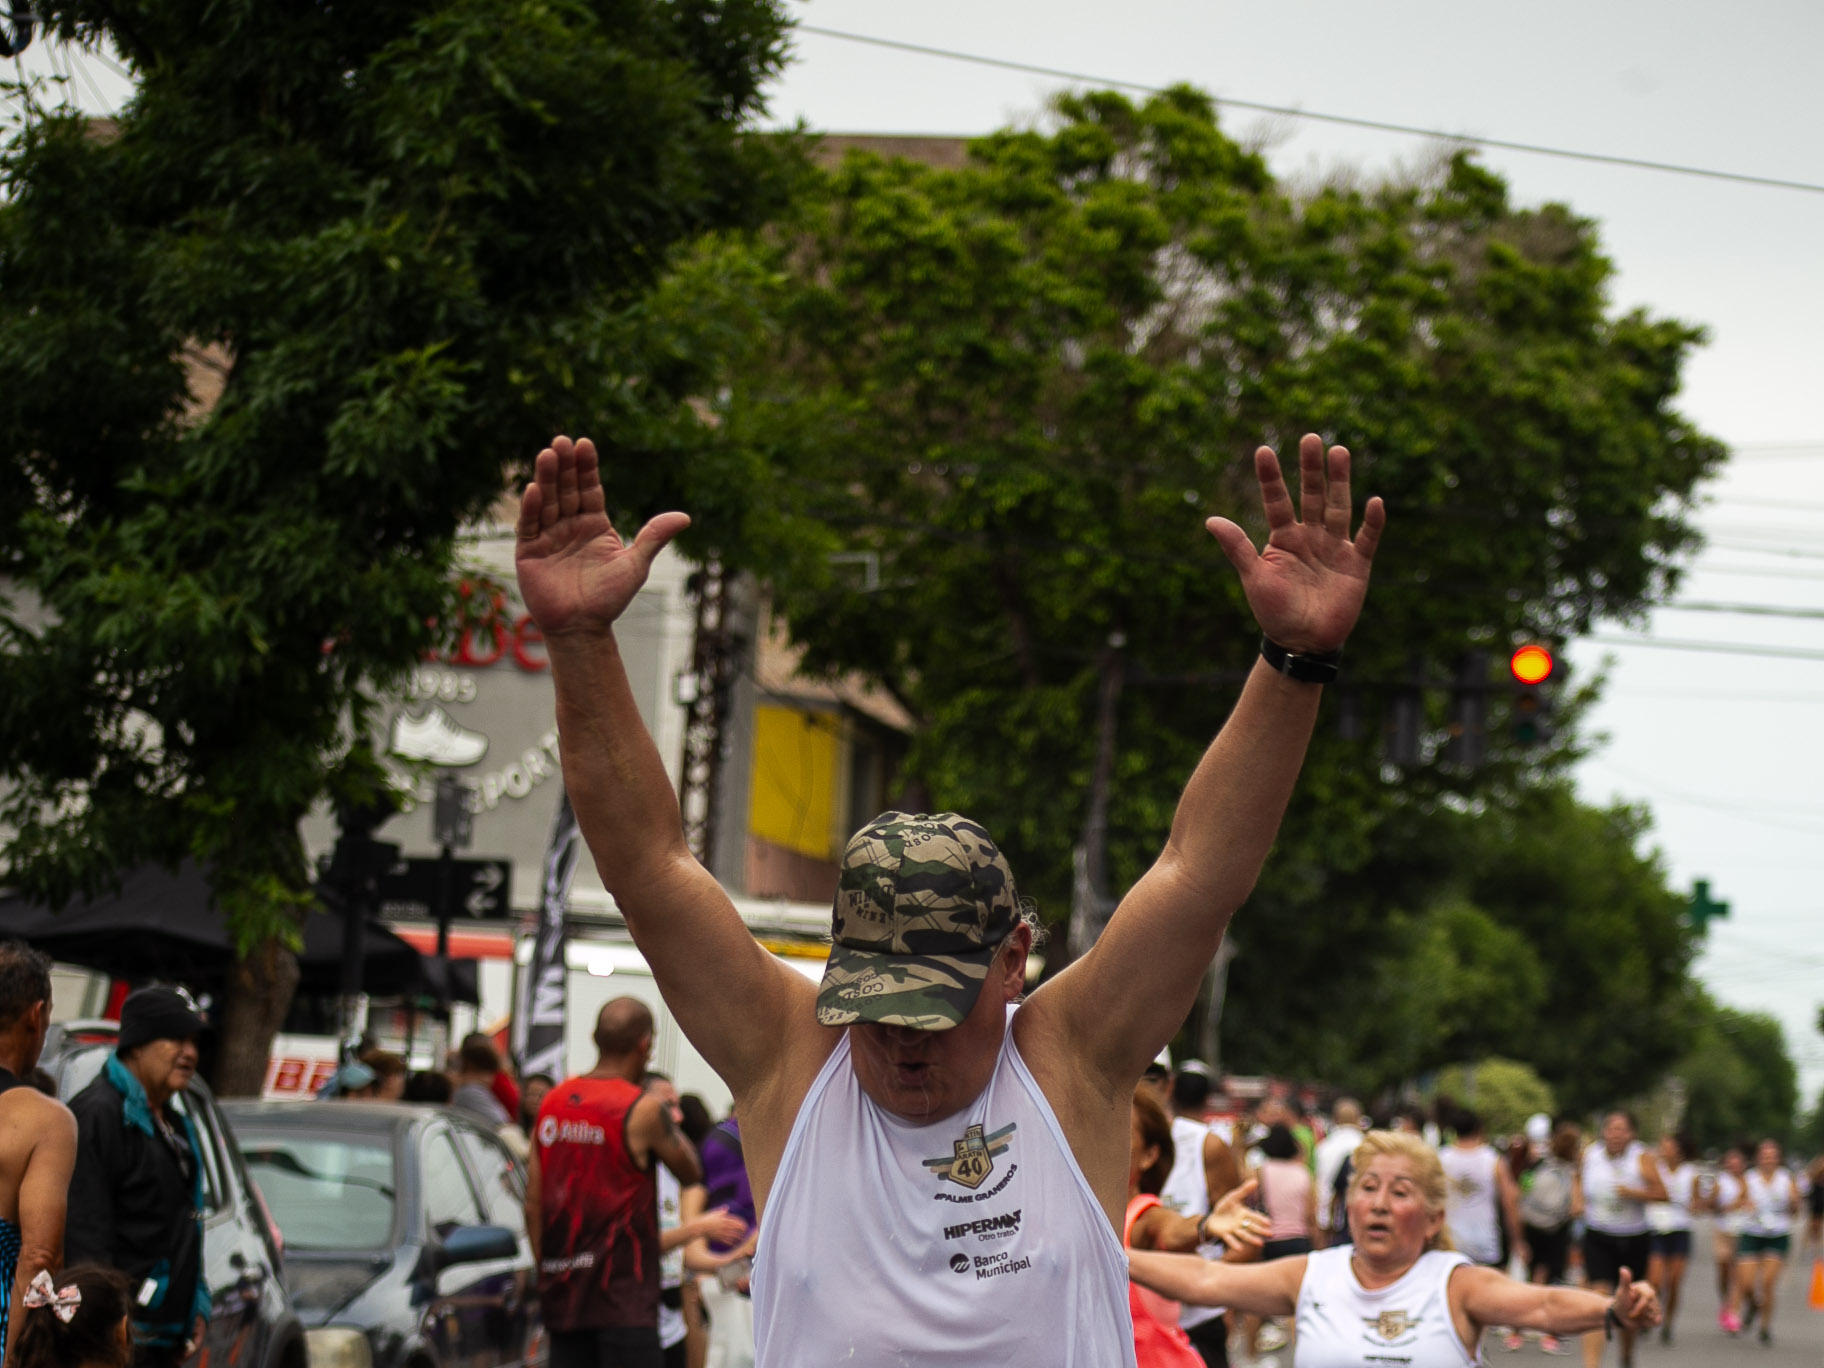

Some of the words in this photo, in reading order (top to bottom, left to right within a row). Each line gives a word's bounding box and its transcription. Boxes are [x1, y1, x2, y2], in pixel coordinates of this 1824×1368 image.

[957, 1157, 983, 1178] 40
[975, 1163, 1018, 1202] GRANEROS
[978, 1233, 996, 1242] Otro
[973, 1251, 1009, 1268] Banco
[976, 1256, 1032, 1281] Municipal
